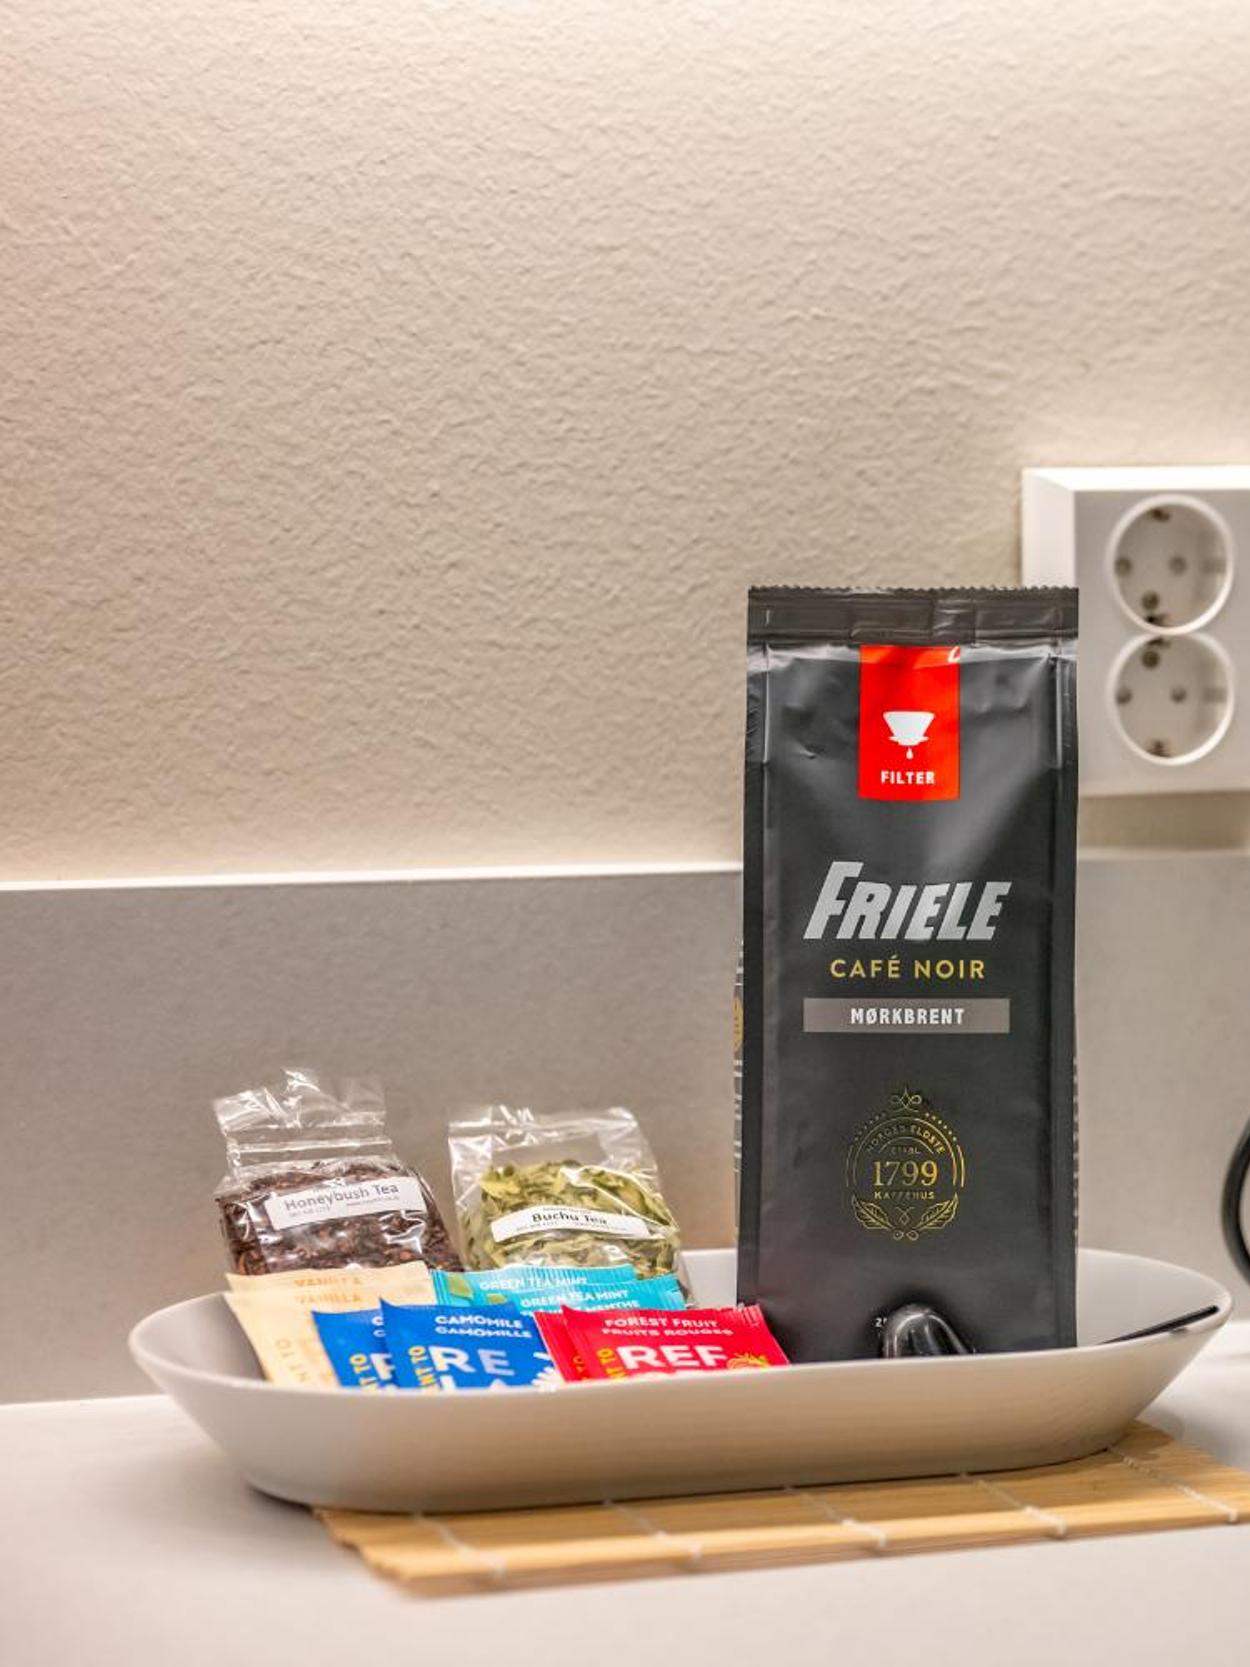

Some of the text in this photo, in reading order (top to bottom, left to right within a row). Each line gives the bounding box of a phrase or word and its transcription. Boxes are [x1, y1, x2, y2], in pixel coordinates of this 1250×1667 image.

[880, 770, 936, 785] FILTER
[803, 861, 1013, 941] FRIELE
[830, 953, 986, 980] CAFÉ NOIR
[850, 1007, 966, 1026] MØRKBRENT
[873, 1160, 938, 1187] 1799
[284, 1187, 370, 1213] Honeybush
[373, 1184, 400, 1196] Tea
[531, 1210, 580, 1223] Buchu
[584, 1213, 608, 1225] Tea
[479, 1276, 587, 1291] GREEN TEA MINT
[520, 1294, 567, 1308] GREEN
[598, 1289, 629, 1300] MINT
[434, 1314, 524, 1329] CAMOMILE
[603, 1317, 719, 1329] FOREST FRUIT
[434, 1325, 533, 1339] CAMOMILLE
[601, 1327, 734, 1337] FRUITS ROUGES
